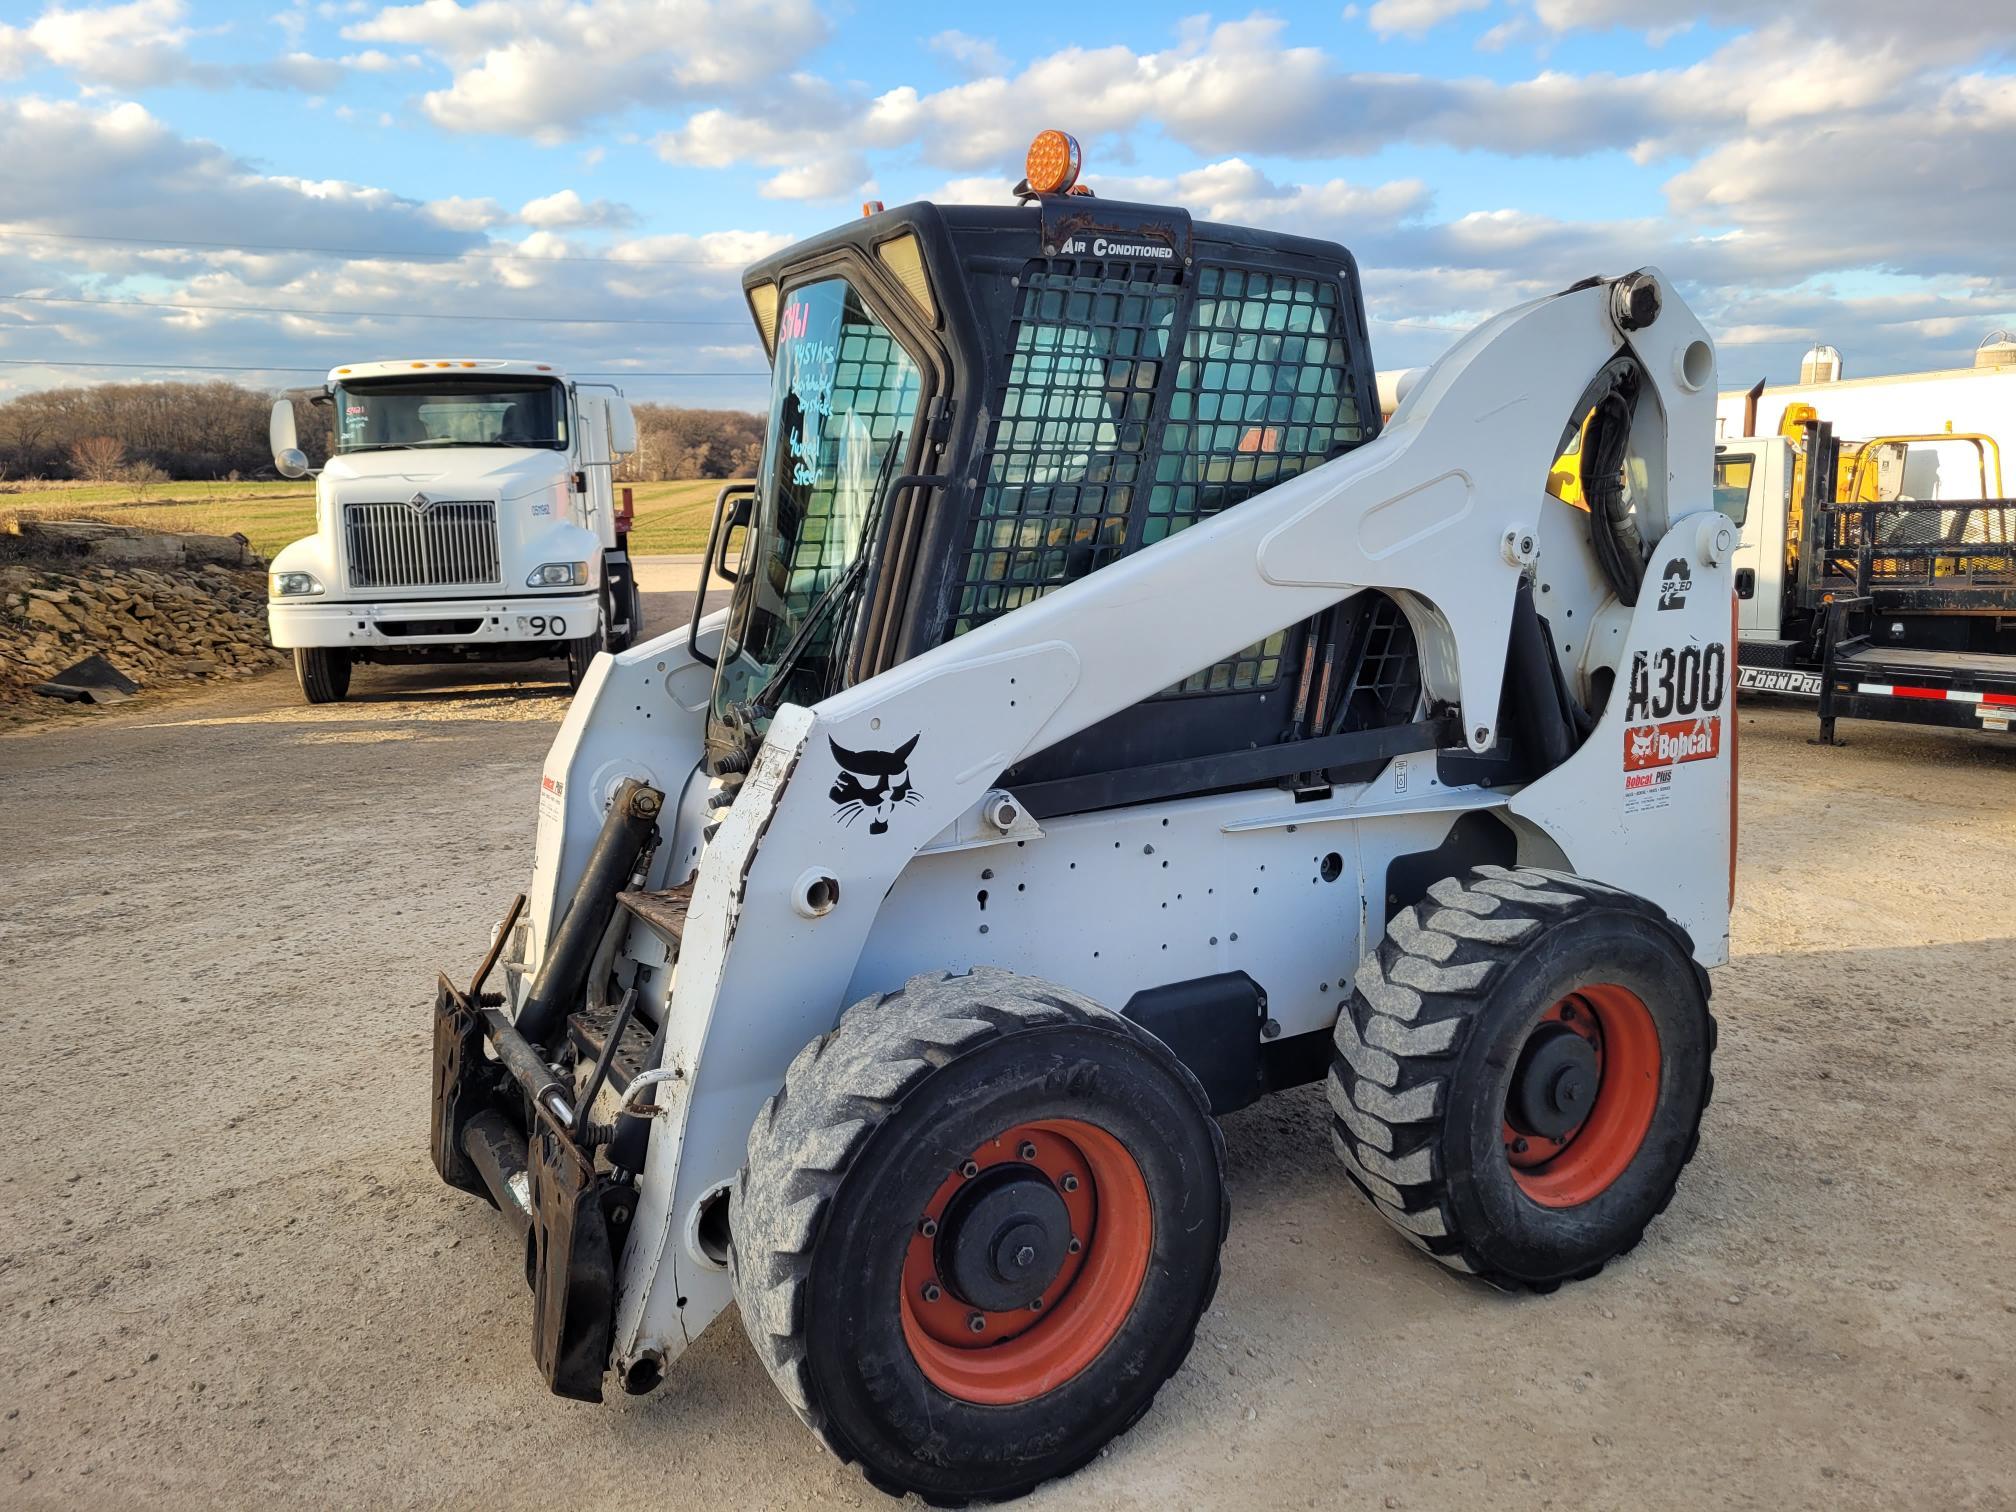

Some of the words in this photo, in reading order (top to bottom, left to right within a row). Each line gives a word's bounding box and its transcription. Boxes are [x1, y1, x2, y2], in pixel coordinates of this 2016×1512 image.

[529, 615, 567, 636] 90
[1625, 642, 1725, 722] A300
[1658, 731, 1712, 760] Bobcat
[1625, 774, 1653, 788] Bobcat
